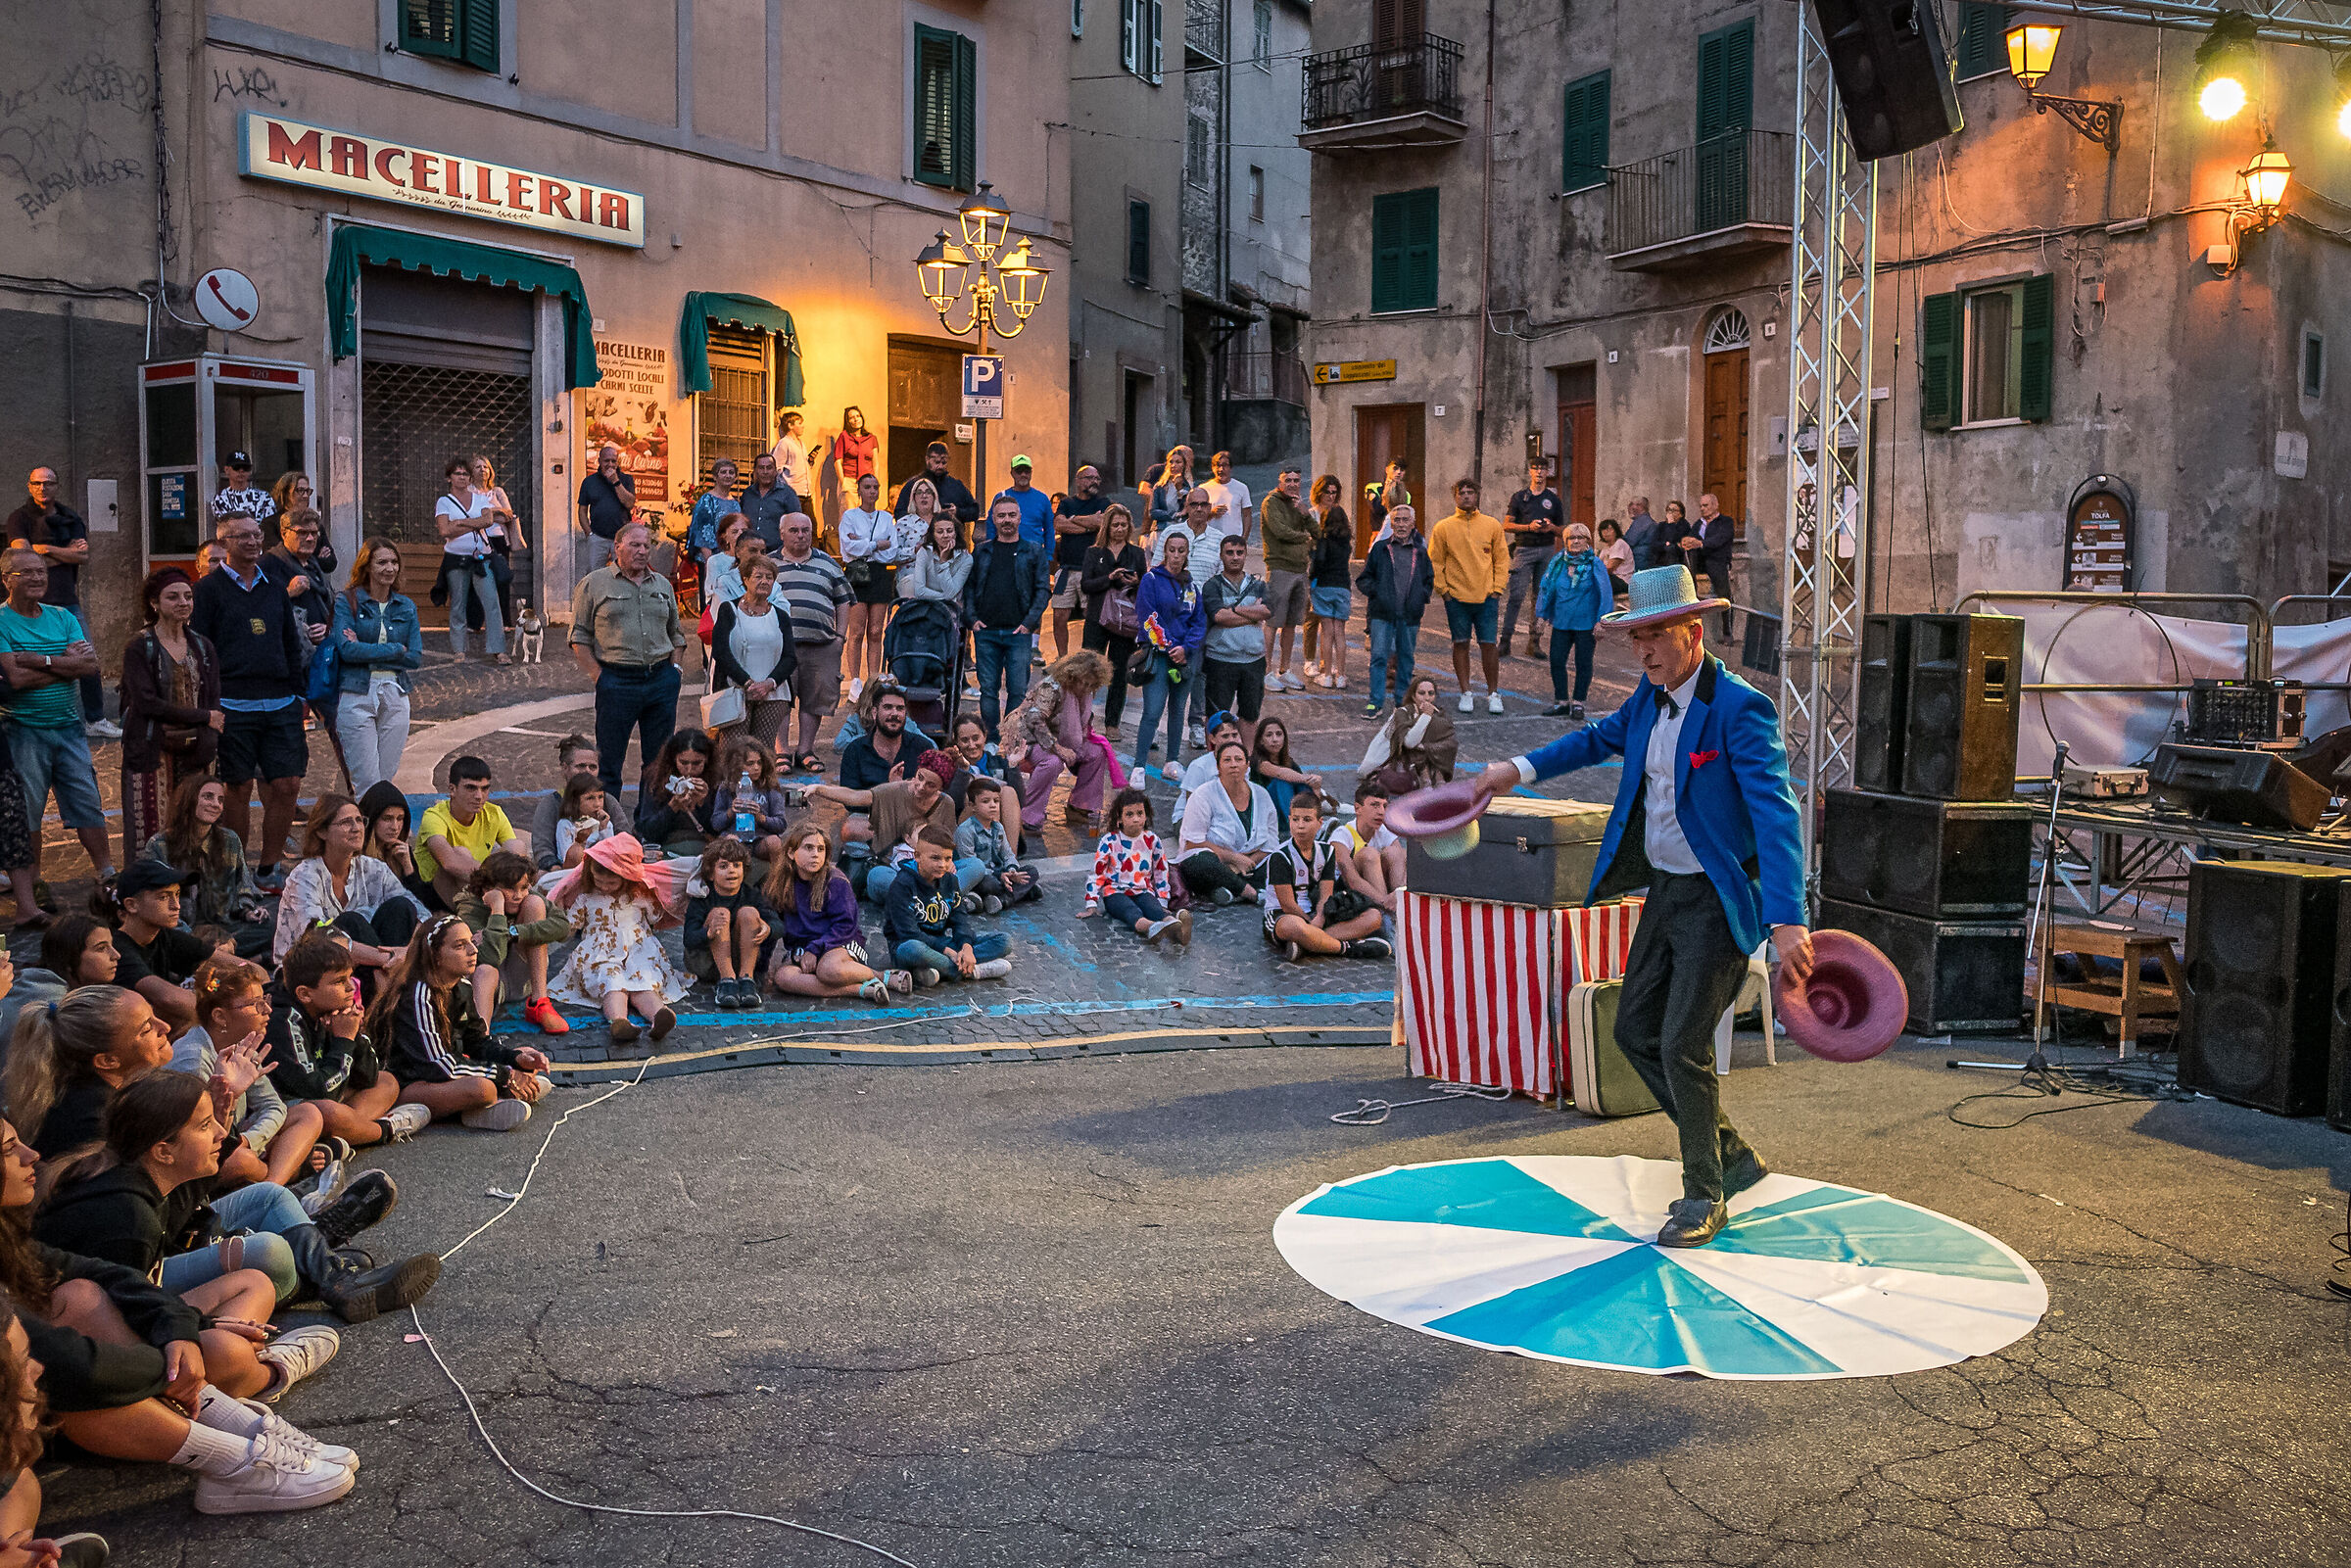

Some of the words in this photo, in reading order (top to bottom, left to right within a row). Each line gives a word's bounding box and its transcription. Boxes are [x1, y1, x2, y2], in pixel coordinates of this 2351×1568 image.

[266, 120, 632, 231] MACELLERIA
[600, 379, 626, 391] CARNI
[629, 383, 654, 395] SCELTE
[602, 368, 634, 380] ODOTTI
[638, 371, 664, 384] LOCALI
[971, 359, 995, 393] P
